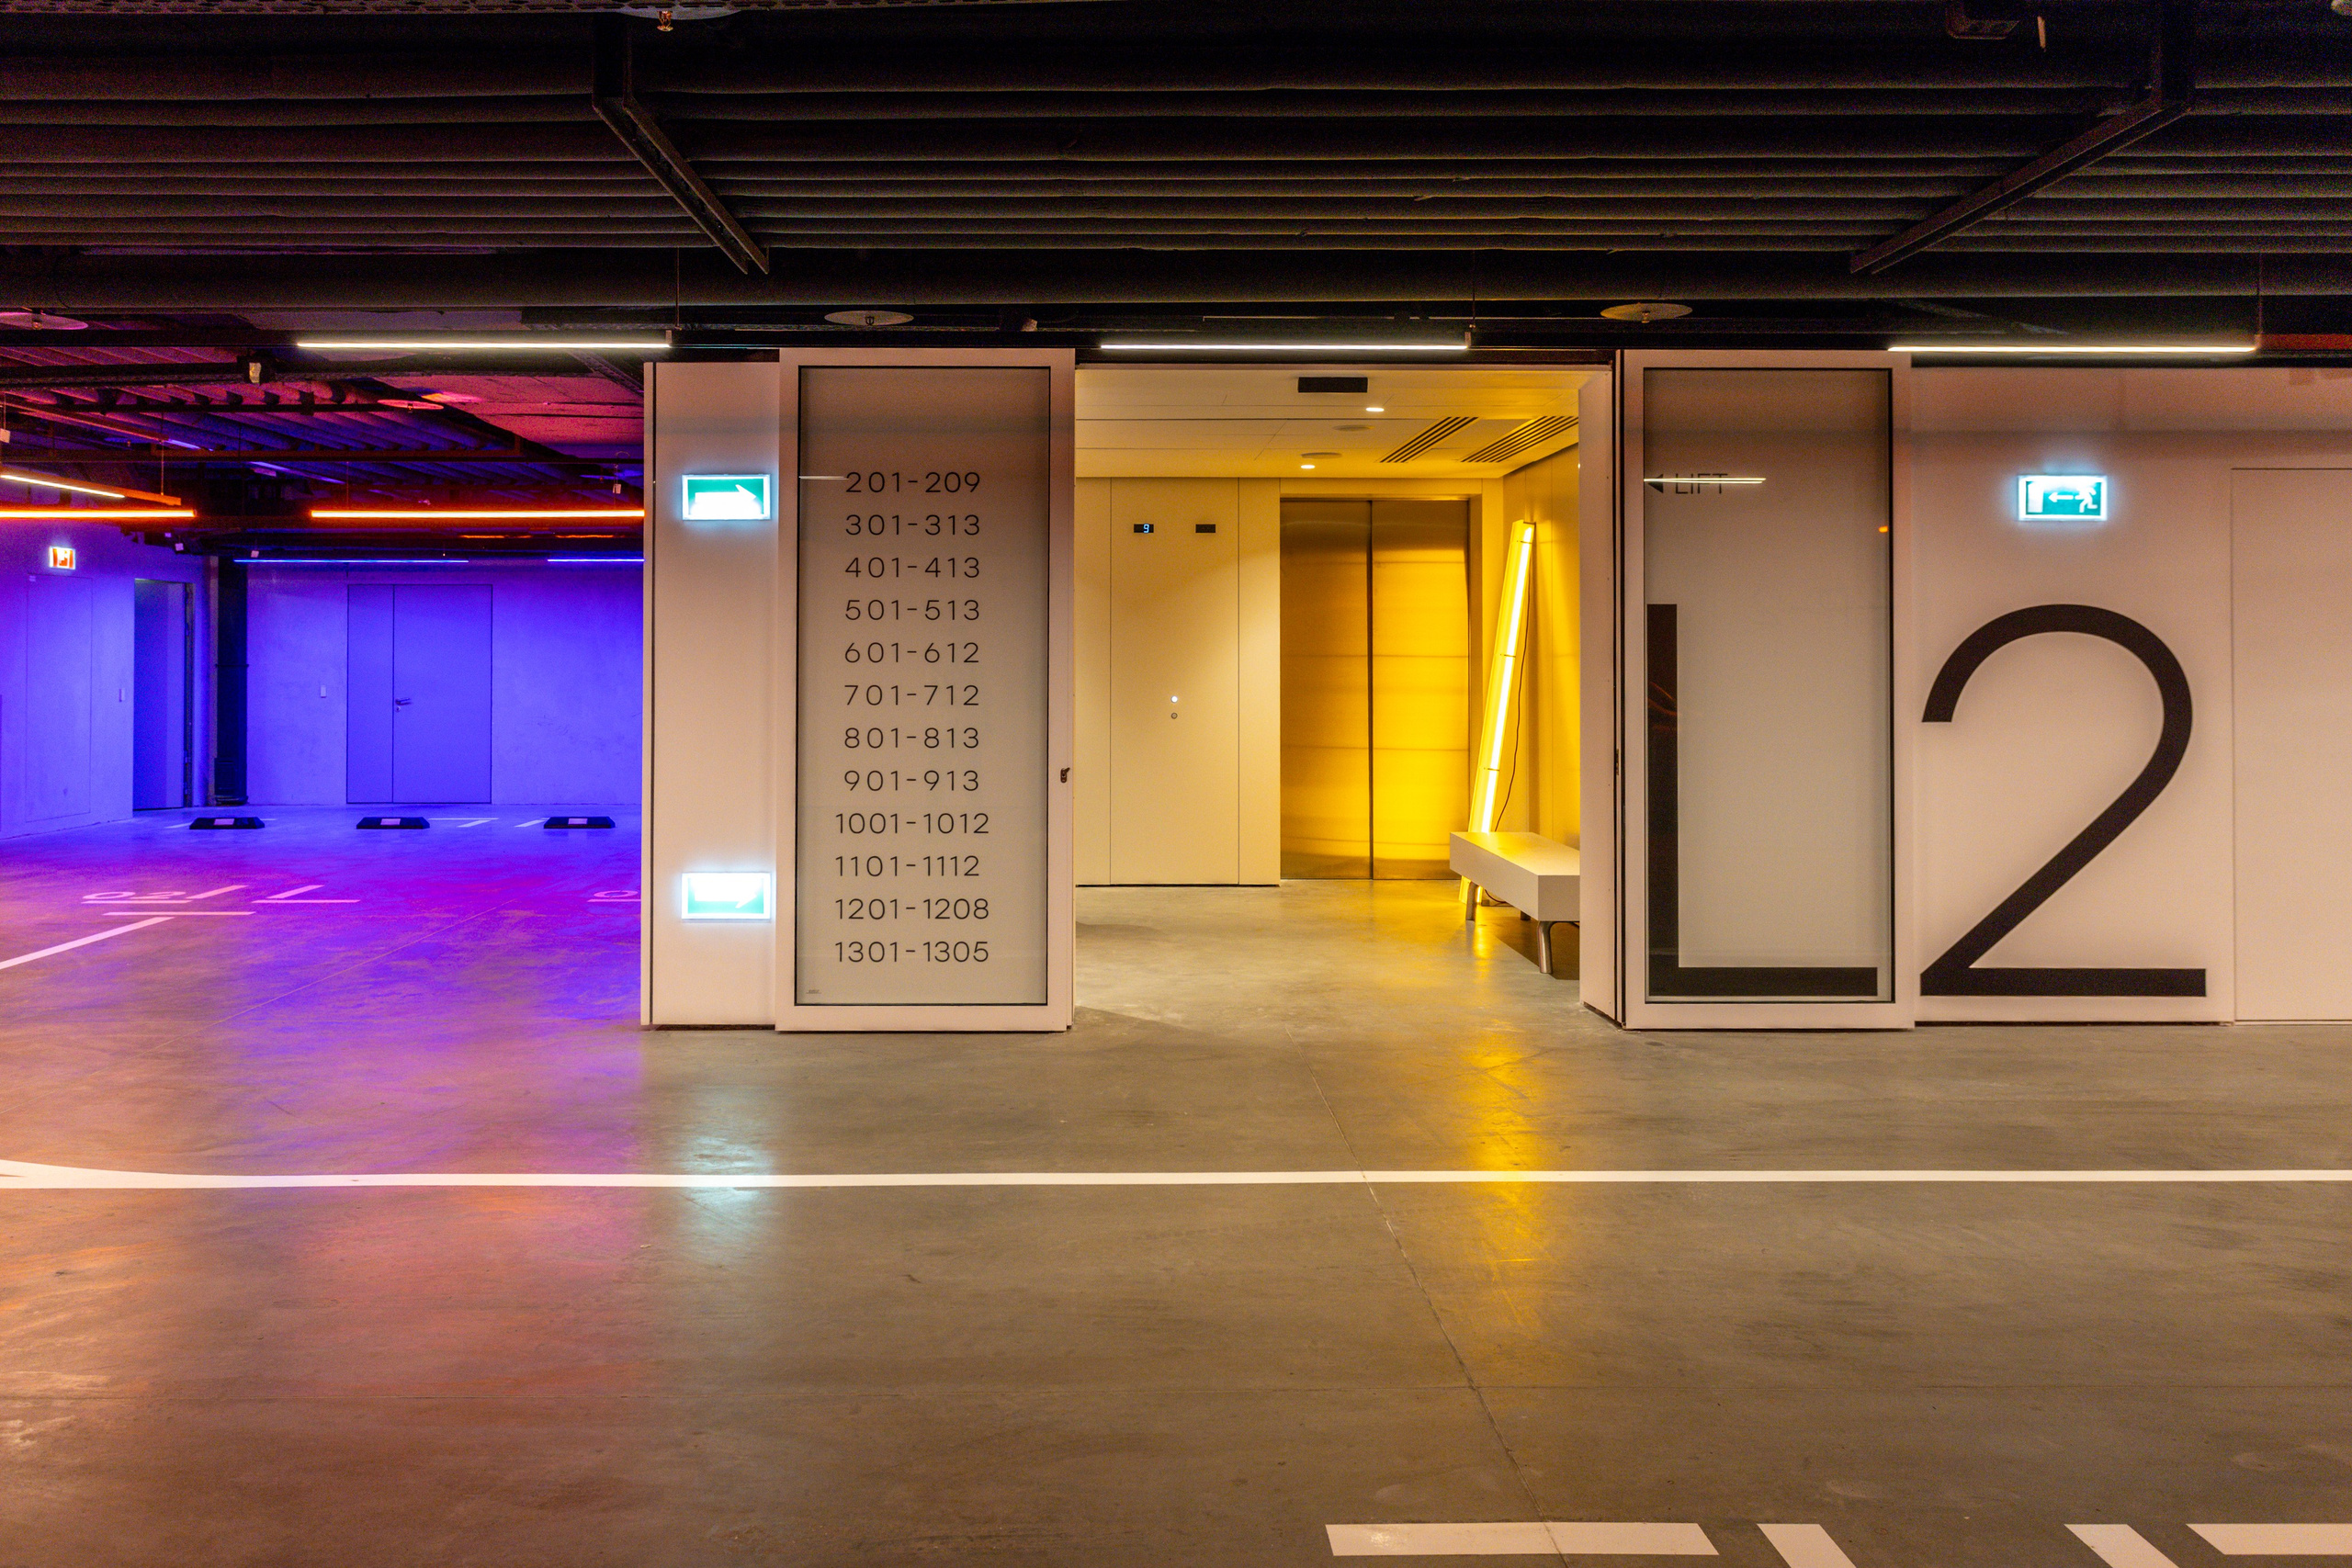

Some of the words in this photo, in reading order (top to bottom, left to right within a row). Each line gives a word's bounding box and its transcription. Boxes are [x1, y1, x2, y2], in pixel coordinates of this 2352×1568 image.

[846, 472, 980, 493] 201-209
[1675, 473, 1728, 494] LIFT
[846, 514, 980, 536] 301-313
[1143, 524, 1149, 533] 9
[845, 558, 979, 579] 401-413
[845, 600, 979, 621] 501-513
[845, 642, 979, 663] 601-612
[844, 685, 979, 706] 701-712
[844, 728, 979, 749] 801-813
[844, 771, 979, 792] 901-913
[835, 813, 989, 834] 1001-1012
[835, 855, 980, 876] 1101-1112
[835, 898, 989, 919] 1201-1208
[835, 942, 989, 963] 1301-1305
